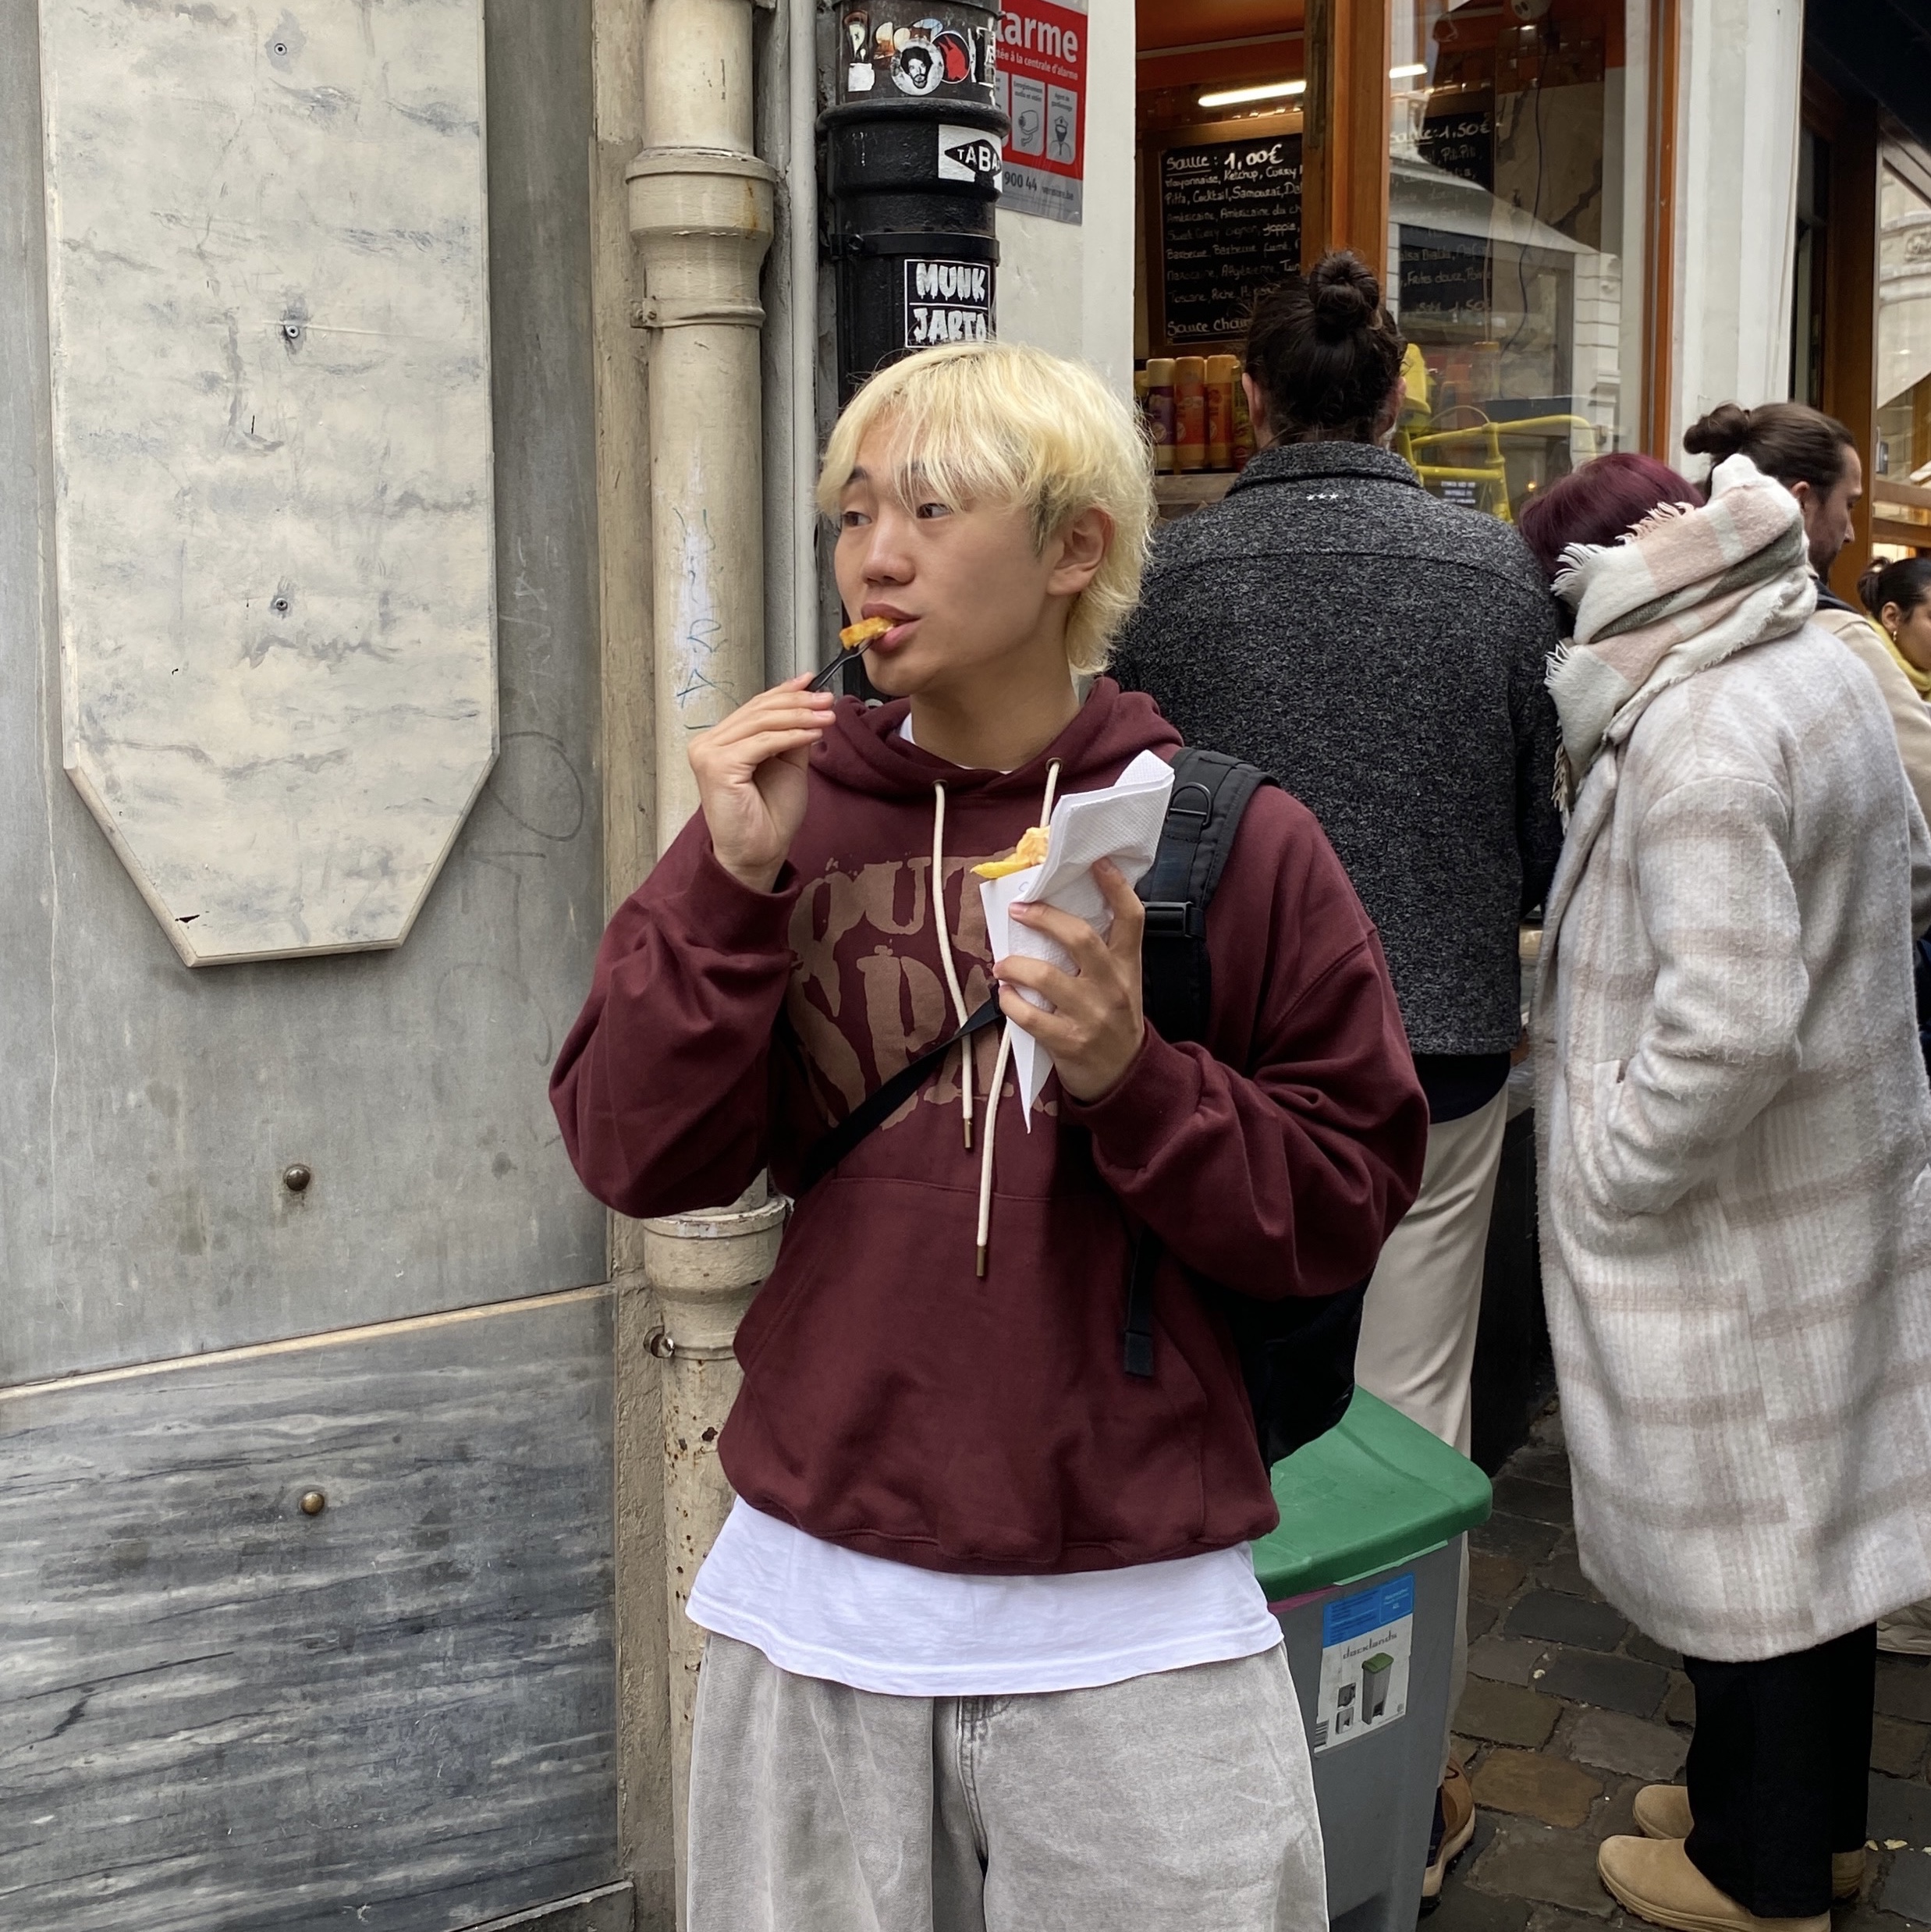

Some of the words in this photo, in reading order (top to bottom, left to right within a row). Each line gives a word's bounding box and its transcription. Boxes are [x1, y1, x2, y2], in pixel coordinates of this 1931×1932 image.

[1223, 144, 1284, 171] 1,00€
[1004, 171, 1024, 187] 900
[1026, 176, 1037, 191] 44
[916, 263, 985, 303] MUNK
